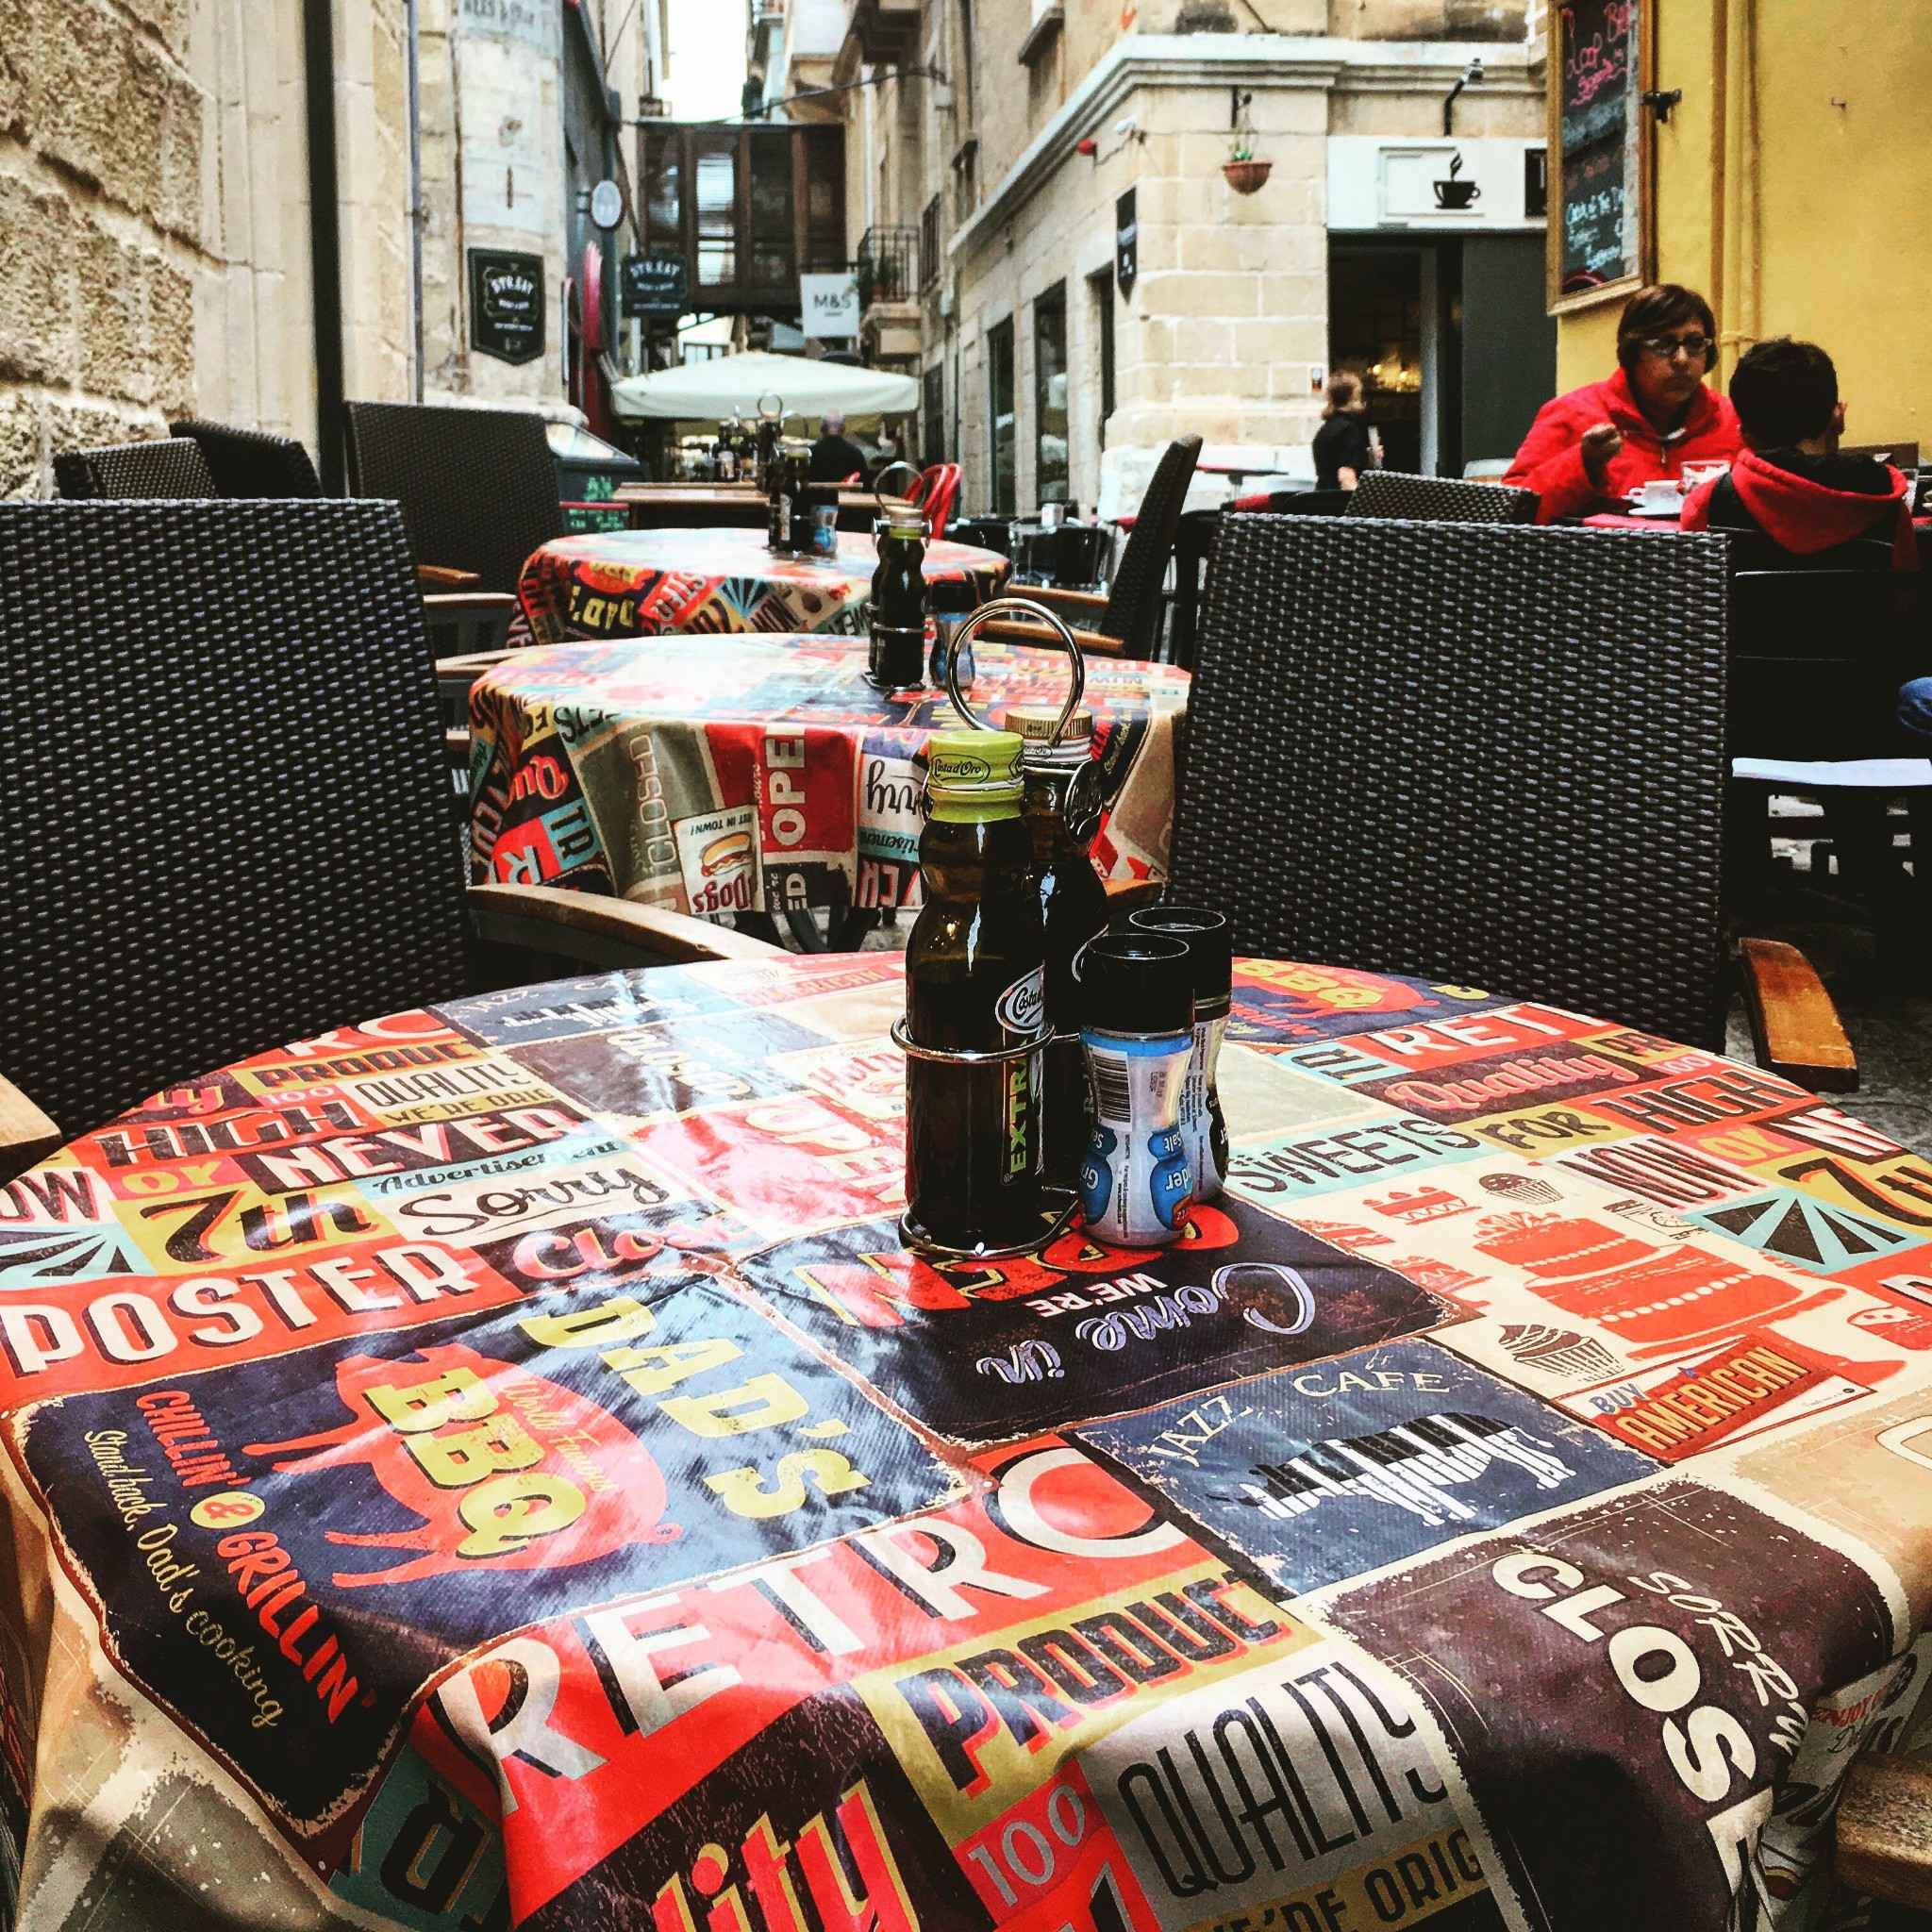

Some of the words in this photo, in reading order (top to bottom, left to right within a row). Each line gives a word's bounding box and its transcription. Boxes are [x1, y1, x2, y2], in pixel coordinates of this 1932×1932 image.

[628, 735, 676, 866] CLOSED
[766, 725, 807, 847] OPE
[264, 1086, 336, 1105] 100
[1383, 1054, 1640, 1110] Quality
[1591, 1070, 1810, 1134] HIGH
[1655, 1054, 1713, 1076] 100
[92, 1101, 367, 1168] HIGH
[1229, 1120, 1480, 1195] SWEETS
[1474, 1110, 1611, 1150] FOR
[140, 1189, 379, 1263] 7th
[399, 1165, 671, 1236] Sorry
[2, 1243, 479, 1376] POSTER
[1024, 1270, 1172, 1319] WE'RE
[1075, 1262, 1316, 1352] Come
[976, 1339, 1066, 1386] in
[1589, 1380, 1647, 1415] BUY
[1615, 1345, 1812, 1451] AMERICAN
[499, 1380, 578, 1430] World
[549, 1427, 623, 1494] Famous
[520, 1295, 873, 1520] DAD'S
[1146, 1391, 1255, 1469] JAZZ
[361, 1367, 589, 1559] BBQ
[83, 1428, 147, 1478] Stand
[137, 1522, 201, 1615] Dad's
[185, 1607, 285, 1729] cooking
[967, 1784, 1086, 1907] 100
